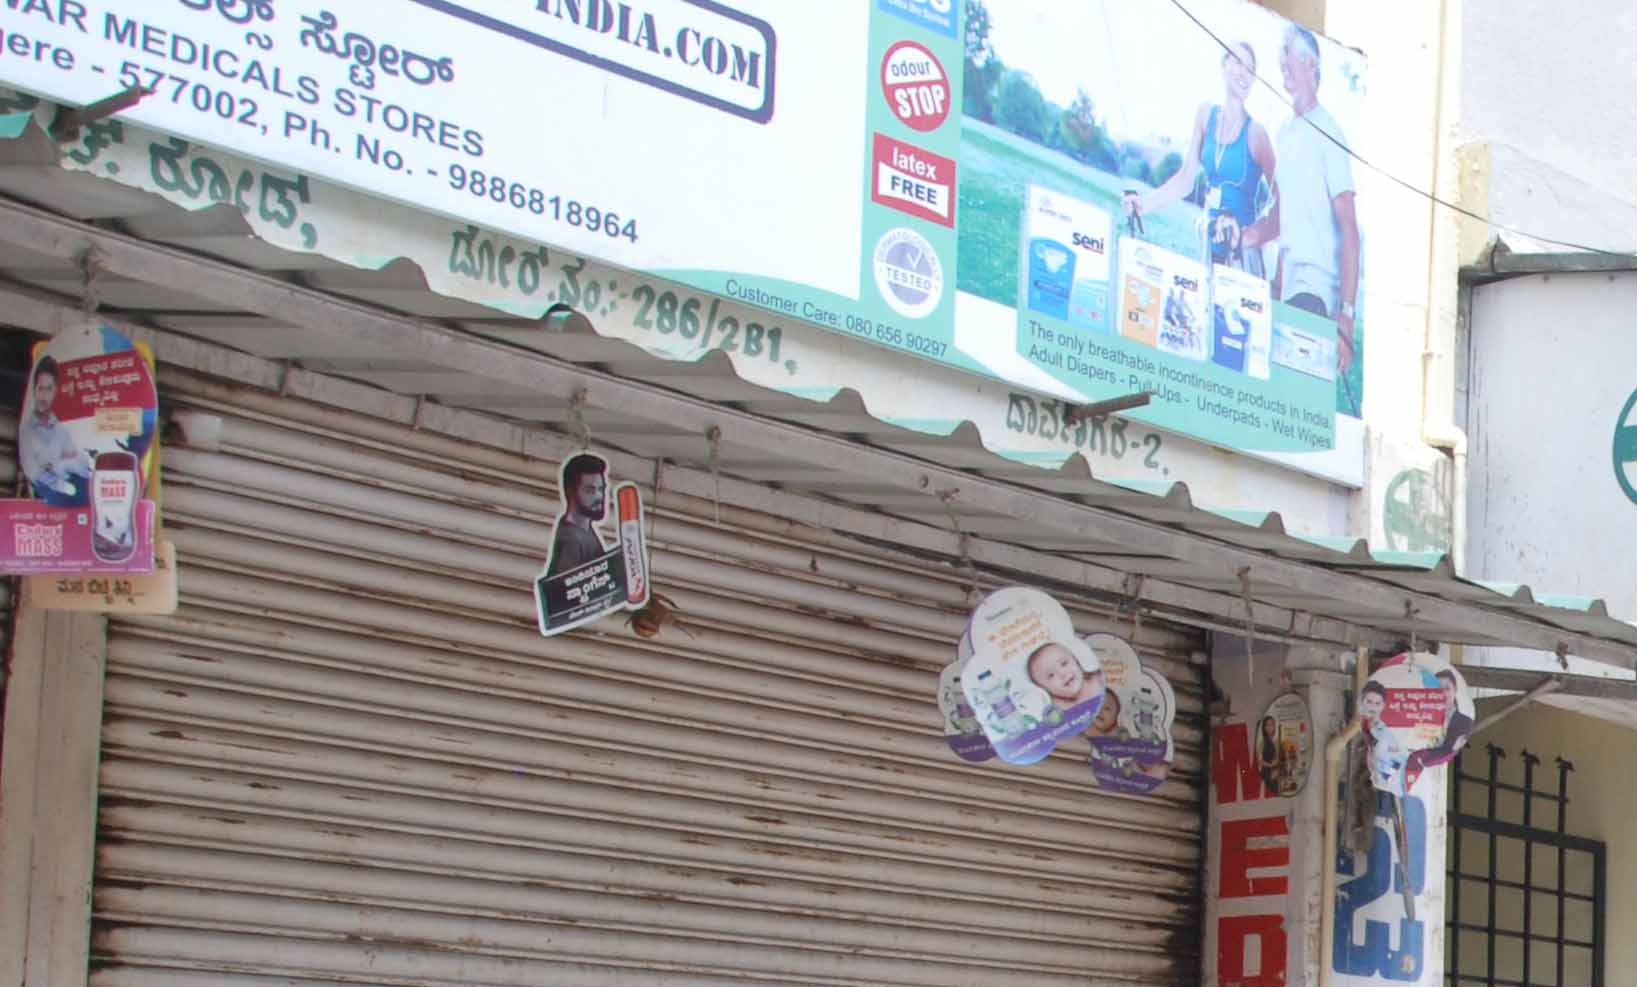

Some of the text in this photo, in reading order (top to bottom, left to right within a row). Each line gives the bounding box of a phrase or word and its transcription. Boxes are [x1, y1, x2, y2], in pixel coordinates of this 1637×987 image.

[536, 0, 762, 89] NDIA.COM
[104, 12, 320, 104] MEDICALS
[333, 88, 485, 157] STORES
[891, 60, 931, 77] odour
[894, 84, 945, 119] STOP
[0, 28, 75, 71] ere
[119, 61, 269, 136] 577002,
[283, 110, 342, 153] Ph.
[355, 133, 414, 175] No.
[448, 162, 639, 243] 9886818964
[892, 147, 937, 180] latex
[890, 174, 938, 205] FREE
[1072, 231, 1105, 254] seni
[886, 267, 932, 292] TESTED
[1173, 274, 1199, 292] seni
[726, 279, 948, 358] Customer Care: 080 656 90297
[1240, 297, 1264, 314] seni
[1029, 320, 1054, 343] The
[1057, 333, 1084, 355] only
[1087, 338, 1155, 375] breathable
[1158, 363, 1236, 398] incontinence
[1237, 388, 1288, 416] products
[1289, 404, 1300, 417] in
[1029, 345, 1064, 366] Adult
[1067, 356, 1117, 386] Diapers
[1196, 396, 1262, 430] Underpads
[1271, 417, 1296, 439] Wet
[1297, 428, 1332, 450] Wipes
